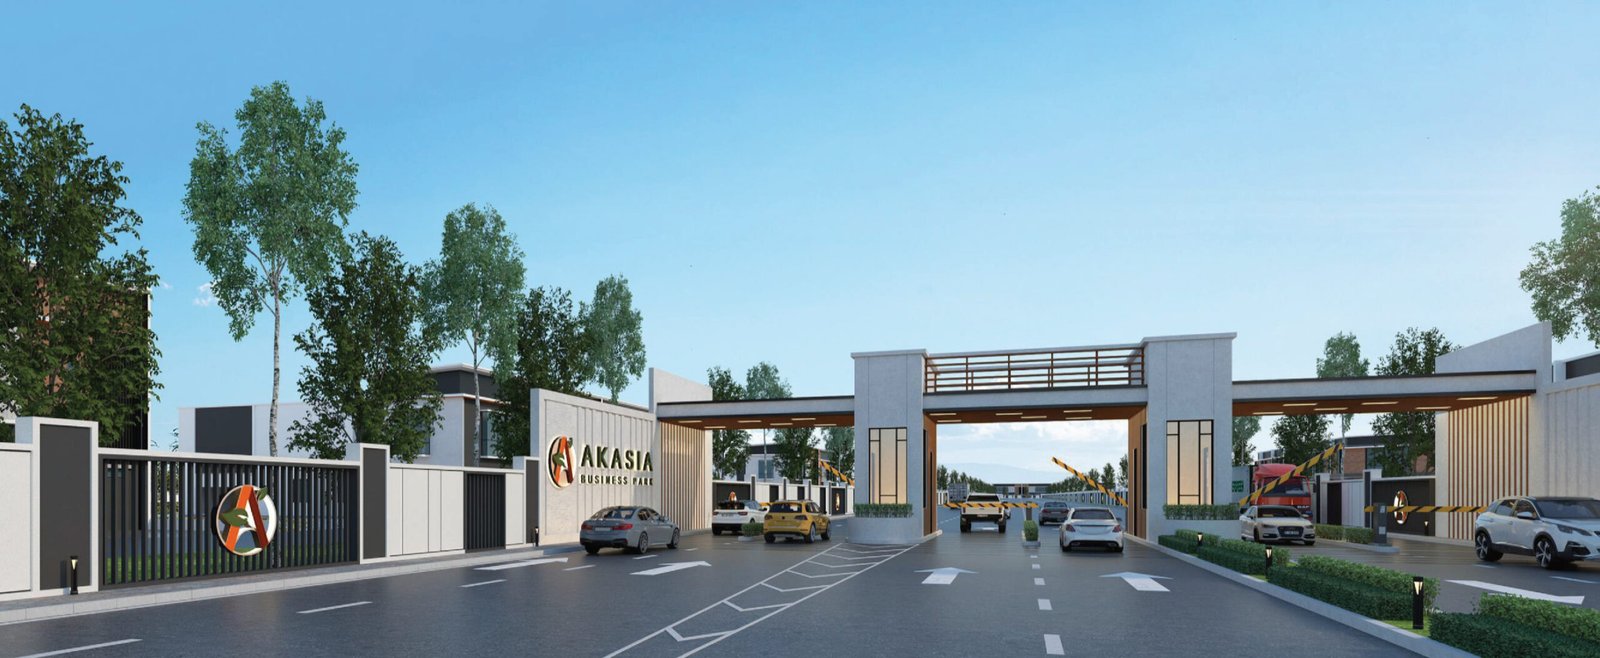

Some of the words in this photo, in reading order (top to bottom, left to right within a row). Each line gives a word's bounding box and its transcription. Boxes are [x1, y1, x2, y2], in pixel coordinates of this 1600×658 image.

[581, 444, 653, 472] AKASIA
[581, 474, 628, 485] BUSINESS
[632, 477, 653, 486] PARK
